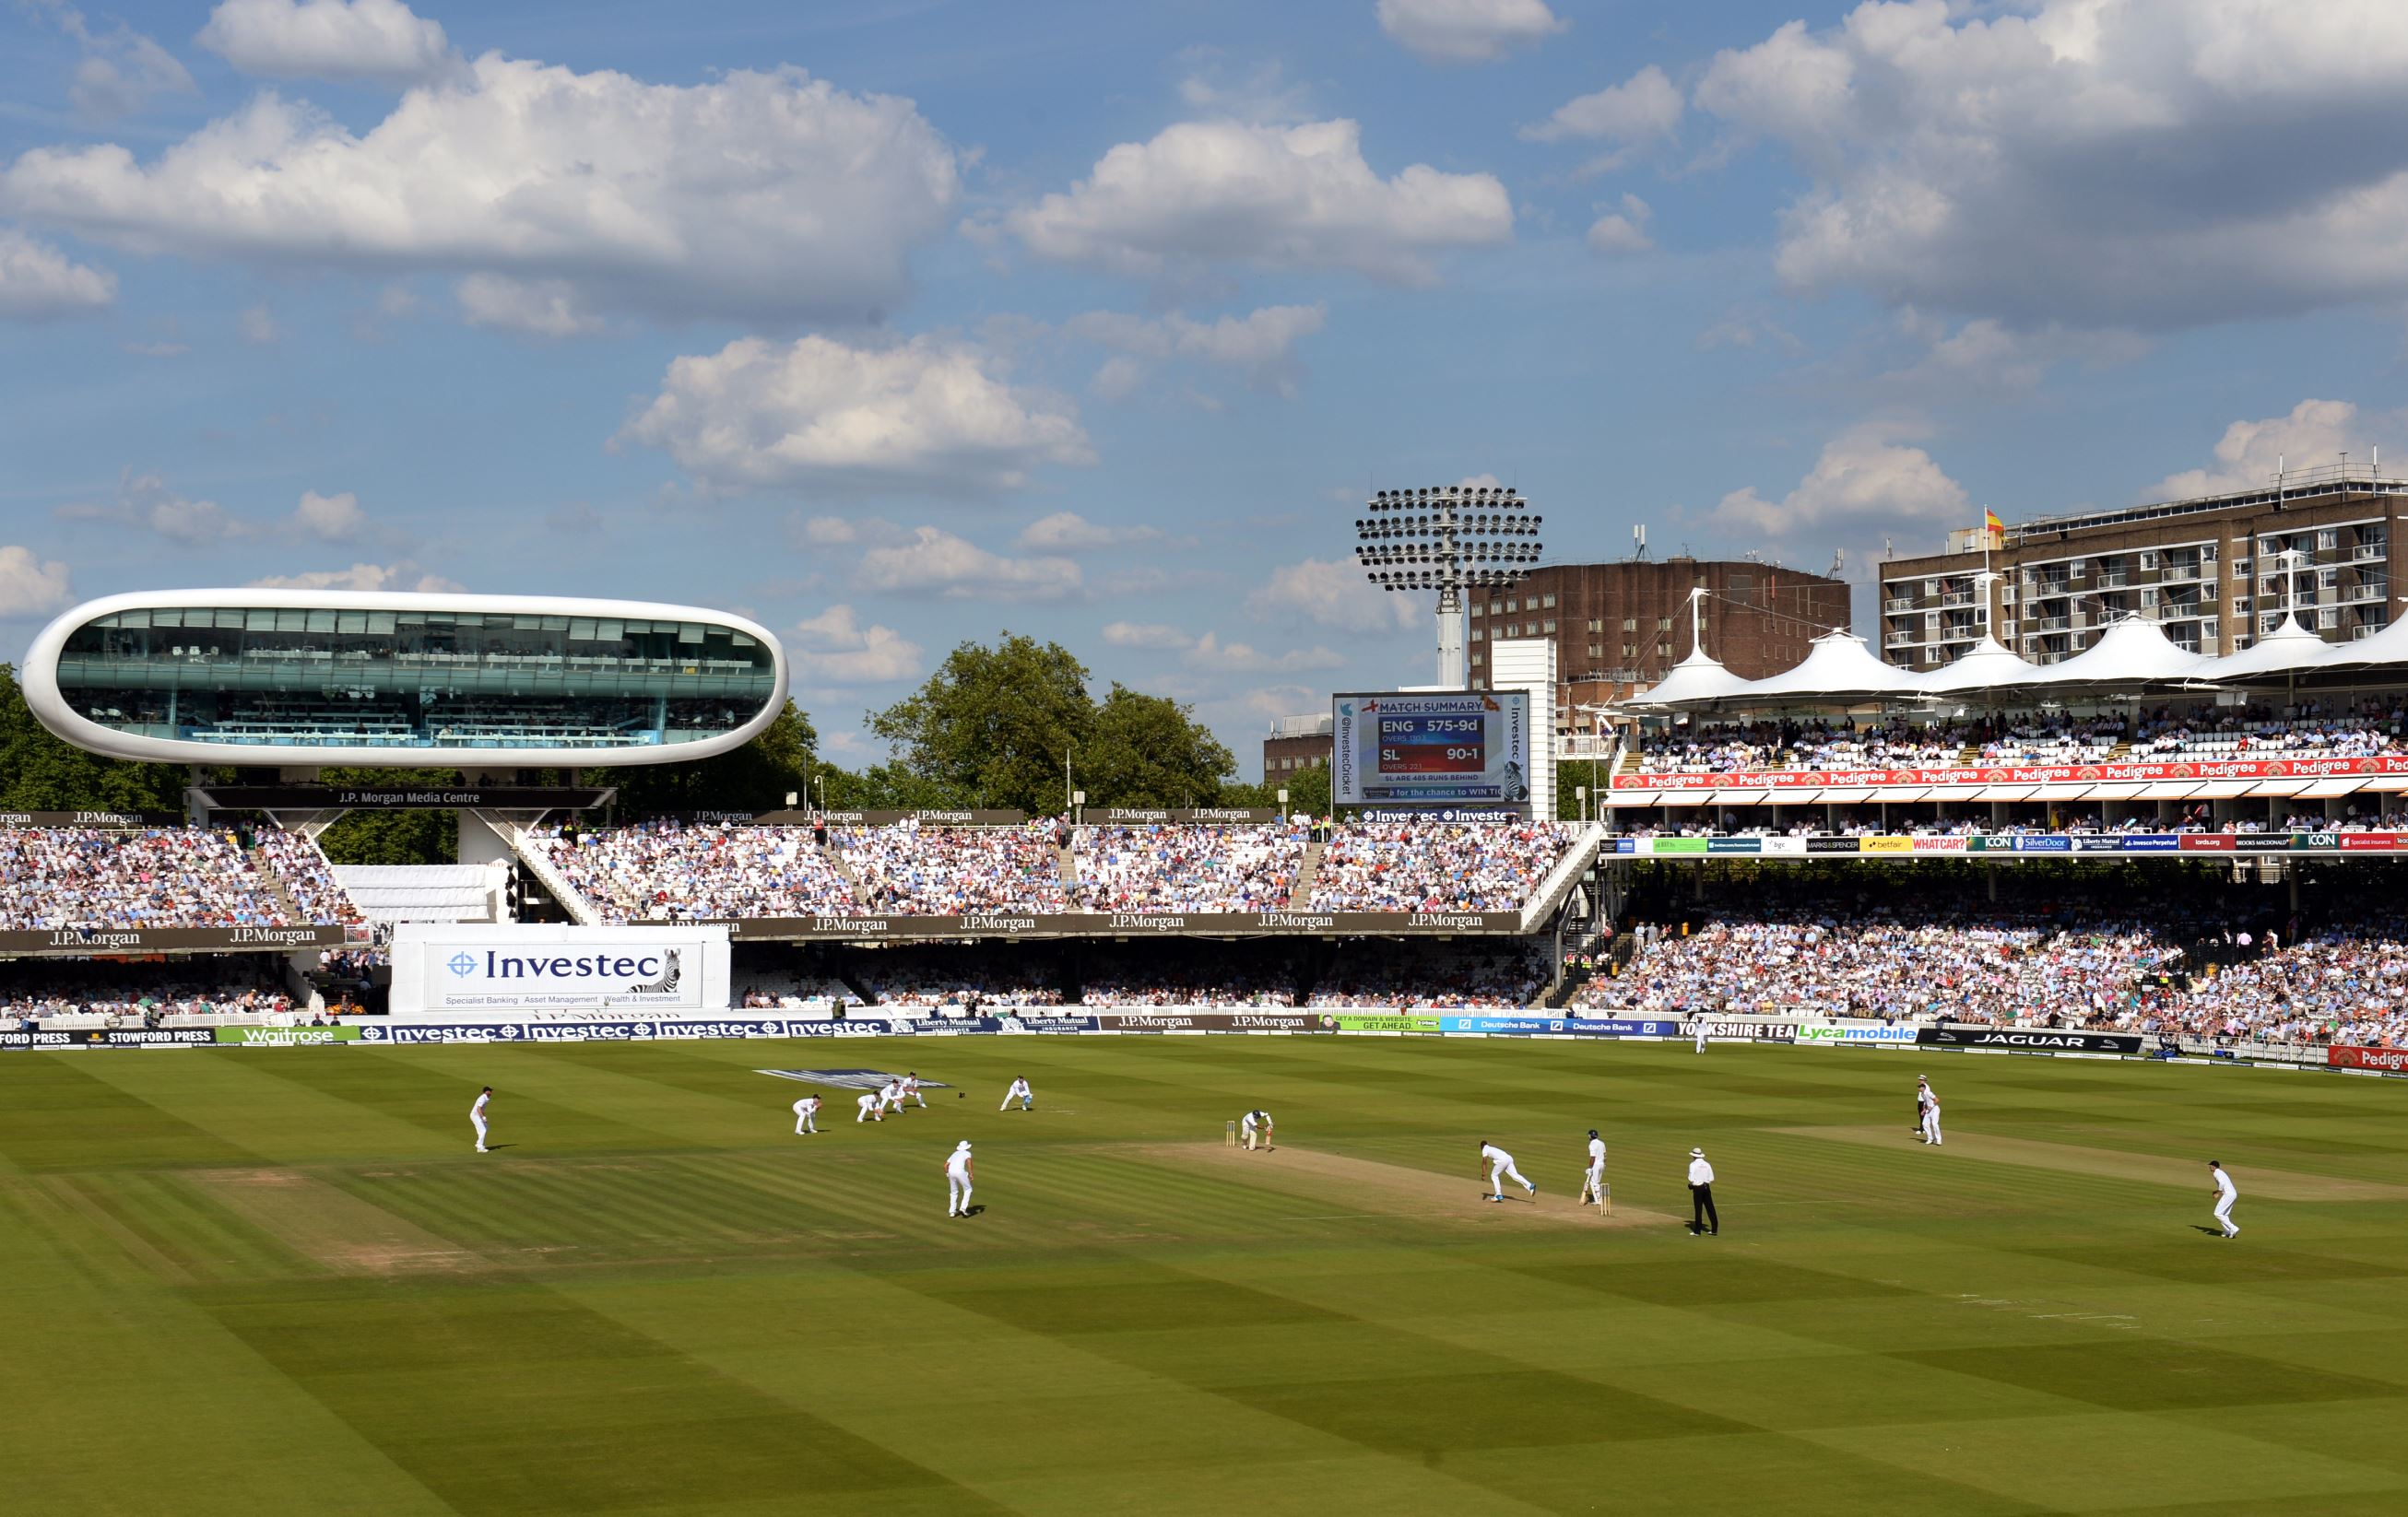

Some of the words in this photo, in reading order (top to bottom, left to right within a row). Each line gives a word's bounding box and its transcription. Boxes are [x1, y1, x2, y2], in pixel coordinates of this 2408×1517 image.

[1380, 702, 1420, 712] MATCH
[1424, 701, 1482, 711] SUMMARY
[1383, 721, 1413, 732] ENG
[1427, 719, 1477, 732] 575-9d
[1512, 707, 1520, 759] Investec
[1341, 717, 1352, 795] @InvestecCricket
[1383, 749, 1400, 760] SL
[1446, 747, 1477, 759] 90-1
[2107, 766, 2163, 780] Pedigree
[2200, 764, 2256, 777] Pedigree
[2293, 760, 2350, 775] Pedigree
[1648, 775, 1705, 788] Pedigree
[1739, 773, 1795, 786] Pedigree
[1830, 772, 1886, 785] Pedigree
[1922, 770, 1977, 783] Pedigree
[2013, 768, 2071, 782] Pedigree
[339, 793, 358, 803] J.P.
[361, 793, 403, 805] Morgan
[407, 792, 440, 803] Media
[443, 793, 479, 803] Centre
[1427, 788, 1455, 796] chance
[73, 812, 143, 826] J.P.Morgan
[804, 810, 863, 824] J.PMorgan
[916, 810, 973, 823] J.P.Morgan
[1108, 808, 1167, 820] J.P.Morgan
[1192, 808, 1250, 820] J.P.Morgan
[1456, 810, 1517, 822] Investe
[1985, 837, 2011, 847] ICON
[2025, 838, 2065, 847] SilverDoor
[2308, 835, 2335, 845] ICON
[812, 918, 887, 934] J.P.Morgan
[960, 916, 1035, 932] J.P.Morgan
[1109, 915, 1184, 931] J.P.Morgan
[1258, 914, 1333, 930] J.P.Morgan
[1409, 913, 1482, 930] J.P.Morgan
[230, 928, 316, 946] J.P.Morgan
[486, 951, 658, 978] Investec
[445, 996, 484, 1005] Specialist
[486, 996, 518, 1005] Banking
[548, 995, 597, 1005] Management
[604, 995, 631, 1004] Wealth
[781, 1020, 881, 1035] Investec
[916, 1018, 948, 1028] Liberty
[949, 1017, 981, 1027] Mutual
[1025, 1017, 1056, 1026] Liberty
[1057, 1017, 1089, 1025] Mutual
[1118, 1016, 1192, 1029] J.P.Morgan
[1232, 1016, 1304, 1029] J.P.Morgan
[1481, 1020, 1518, 1029] Deutsche
[1519, 1021, 1540, 1029] Bank
[1573, 1022, 1611, 1030] Deutsche
[1611, 1023, 1634, 1031] Bank
[243, 1028, 334, 1042] Waitrose
[385, 1026, 497, 1041] Investec
[522, 1024, 630, 1039] Investec
[655, 1021, 758, 1036] Investec
[1678, 1022, 1763, 1037] YOKSHIRE
[1765, 1024, 1795, 1038] TEA
[1799, 1024, 1917, 1040] Lycamobile
[32, 1032, 71, 1043] PRESS
[109, 1031, 172, 1043] STOWFORD
[174, 1031, 211, 1041] PRESS
[1974, 1033, 2084, 1048] JAGUAR
